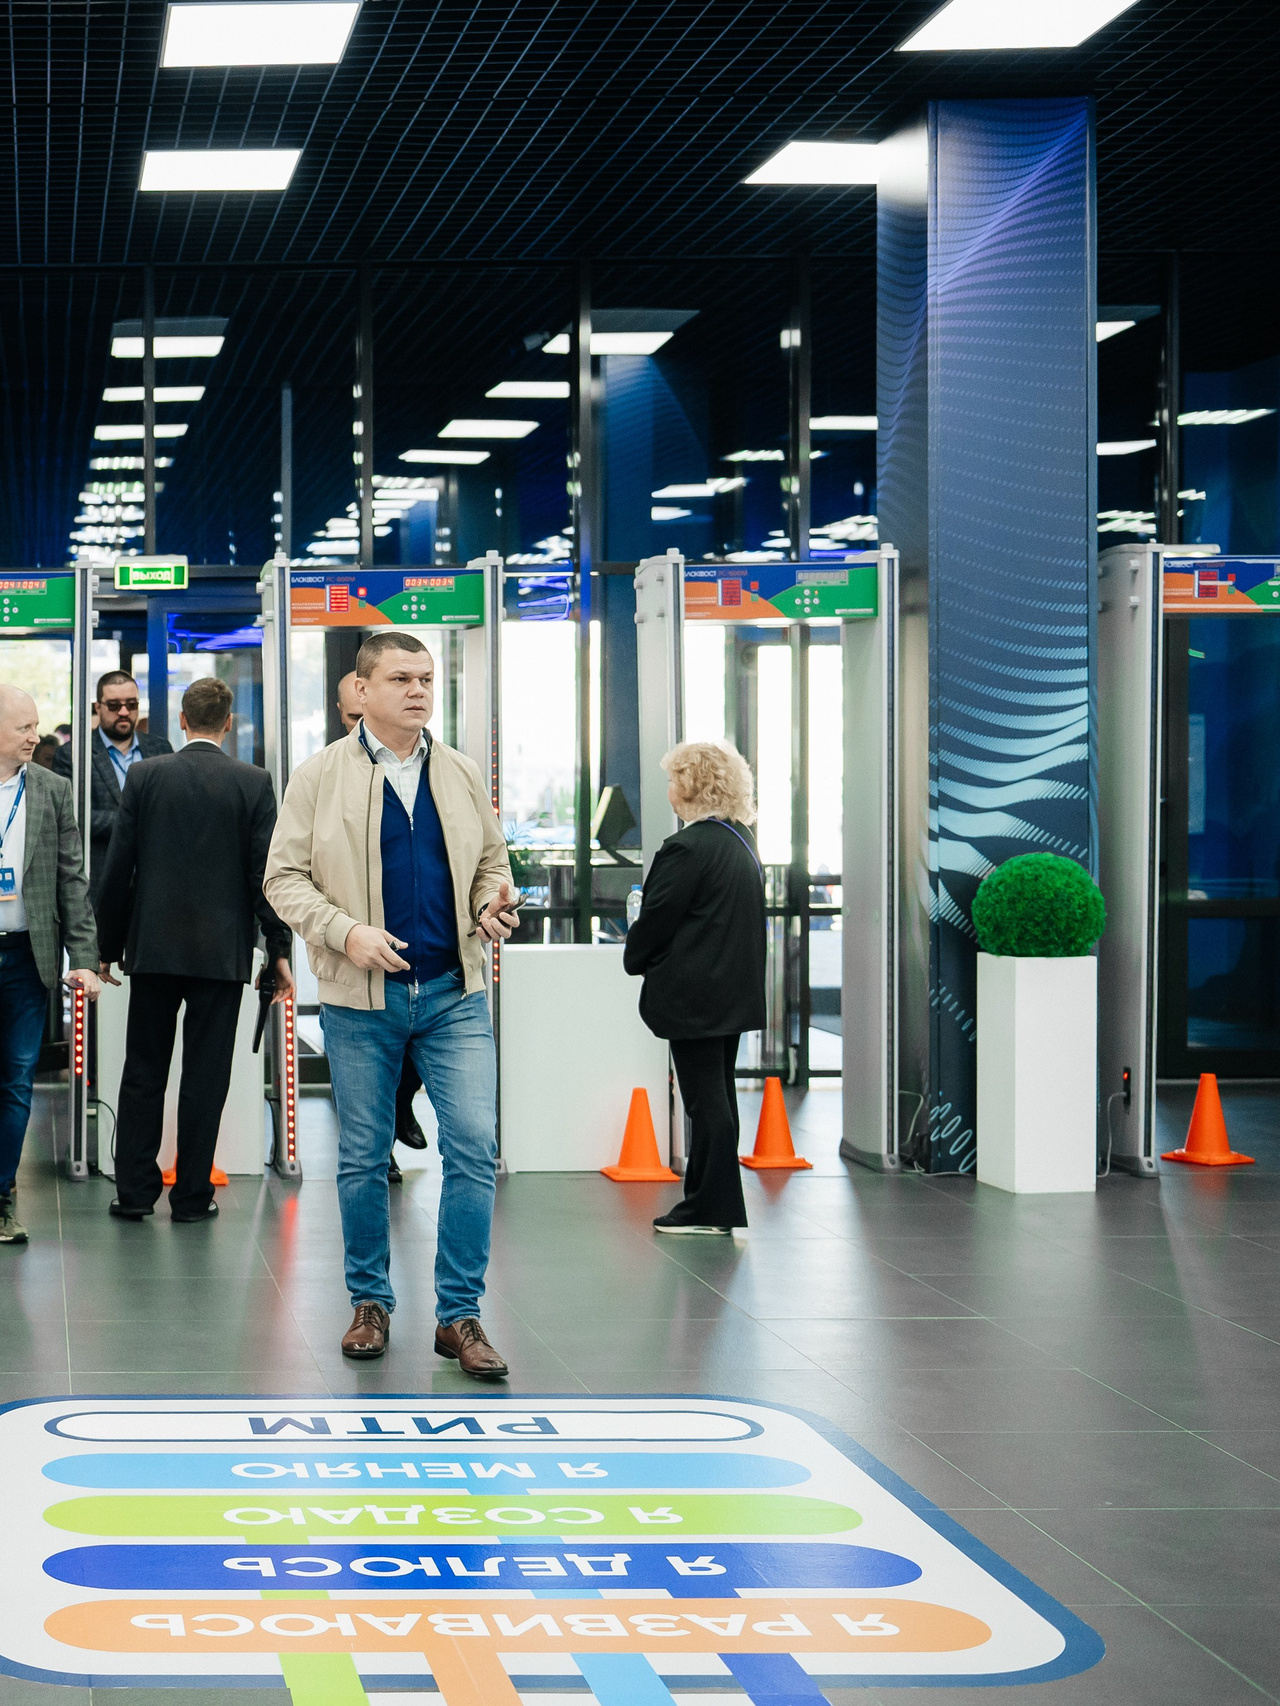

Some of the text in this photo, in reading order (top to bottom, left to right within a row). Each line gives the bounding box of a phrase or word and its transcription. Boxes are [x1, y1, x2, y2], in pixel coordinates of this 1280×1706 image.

[132, 570, 171, 581] ВЫХОД
[248, 1416, 560, 1435] РИТМ
[231, 1462, 609, 1479] Я МЕНЯЮ
[222, 1504, 684, 1526] Я СОЗДАЮ
[222, 1554, 727, 1577] Я ДЕЛЮСЬ
[129, 1612, 901, 1637] Я РАЗВИВАЮСЬ
